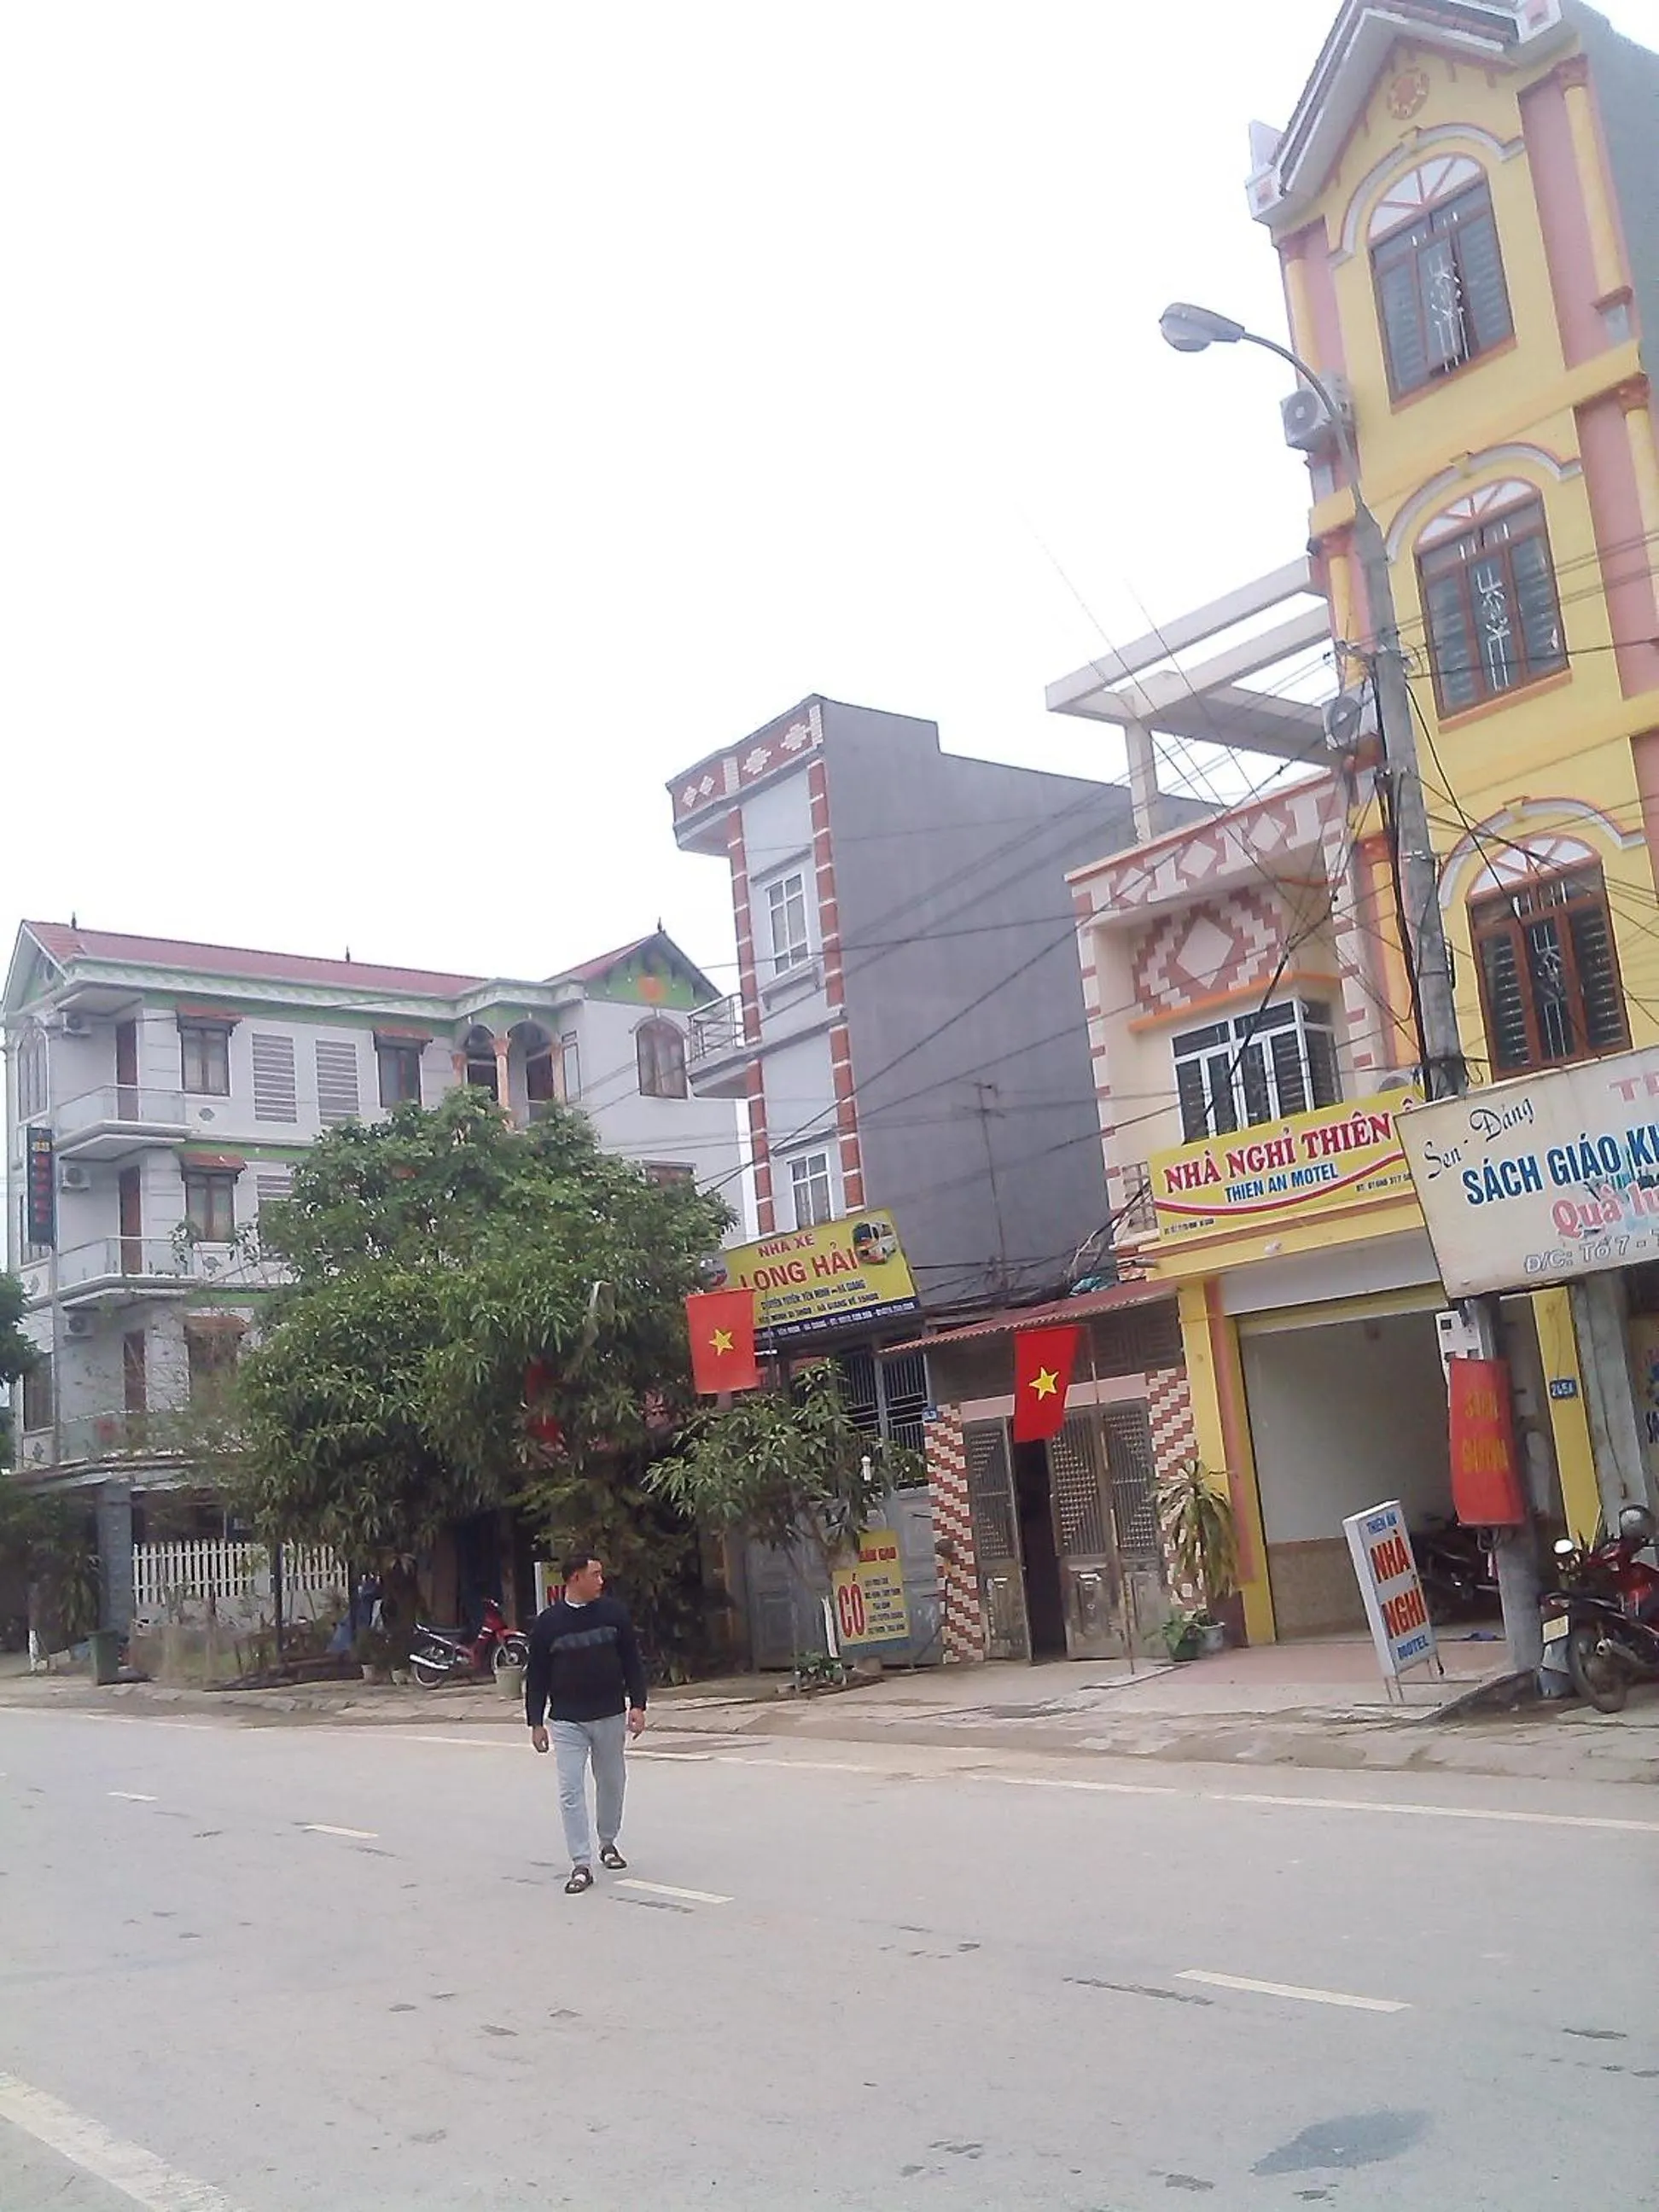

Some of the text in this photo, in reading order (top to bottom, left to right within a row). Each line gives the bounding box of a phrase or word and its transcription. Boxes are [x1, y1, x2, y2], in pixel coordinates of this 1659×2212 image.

[1163, 1111, 1394, 1194] NHÀ NGHỈ THIÊN
[1461, 1156, 1544, 1206] SÁCH
[1546, 1132, 1621, 1187] GIÁO
[1225, 1162, 1339, 1204] THIEN AN MOTEL
[1552, 1184, 1622, 1239] Quà
[811, 1242, 859, 1278] HẢI
[1615, 1236, 1630, 1256] 7
[1370, 1529, 1411, 1584] NHÀ
